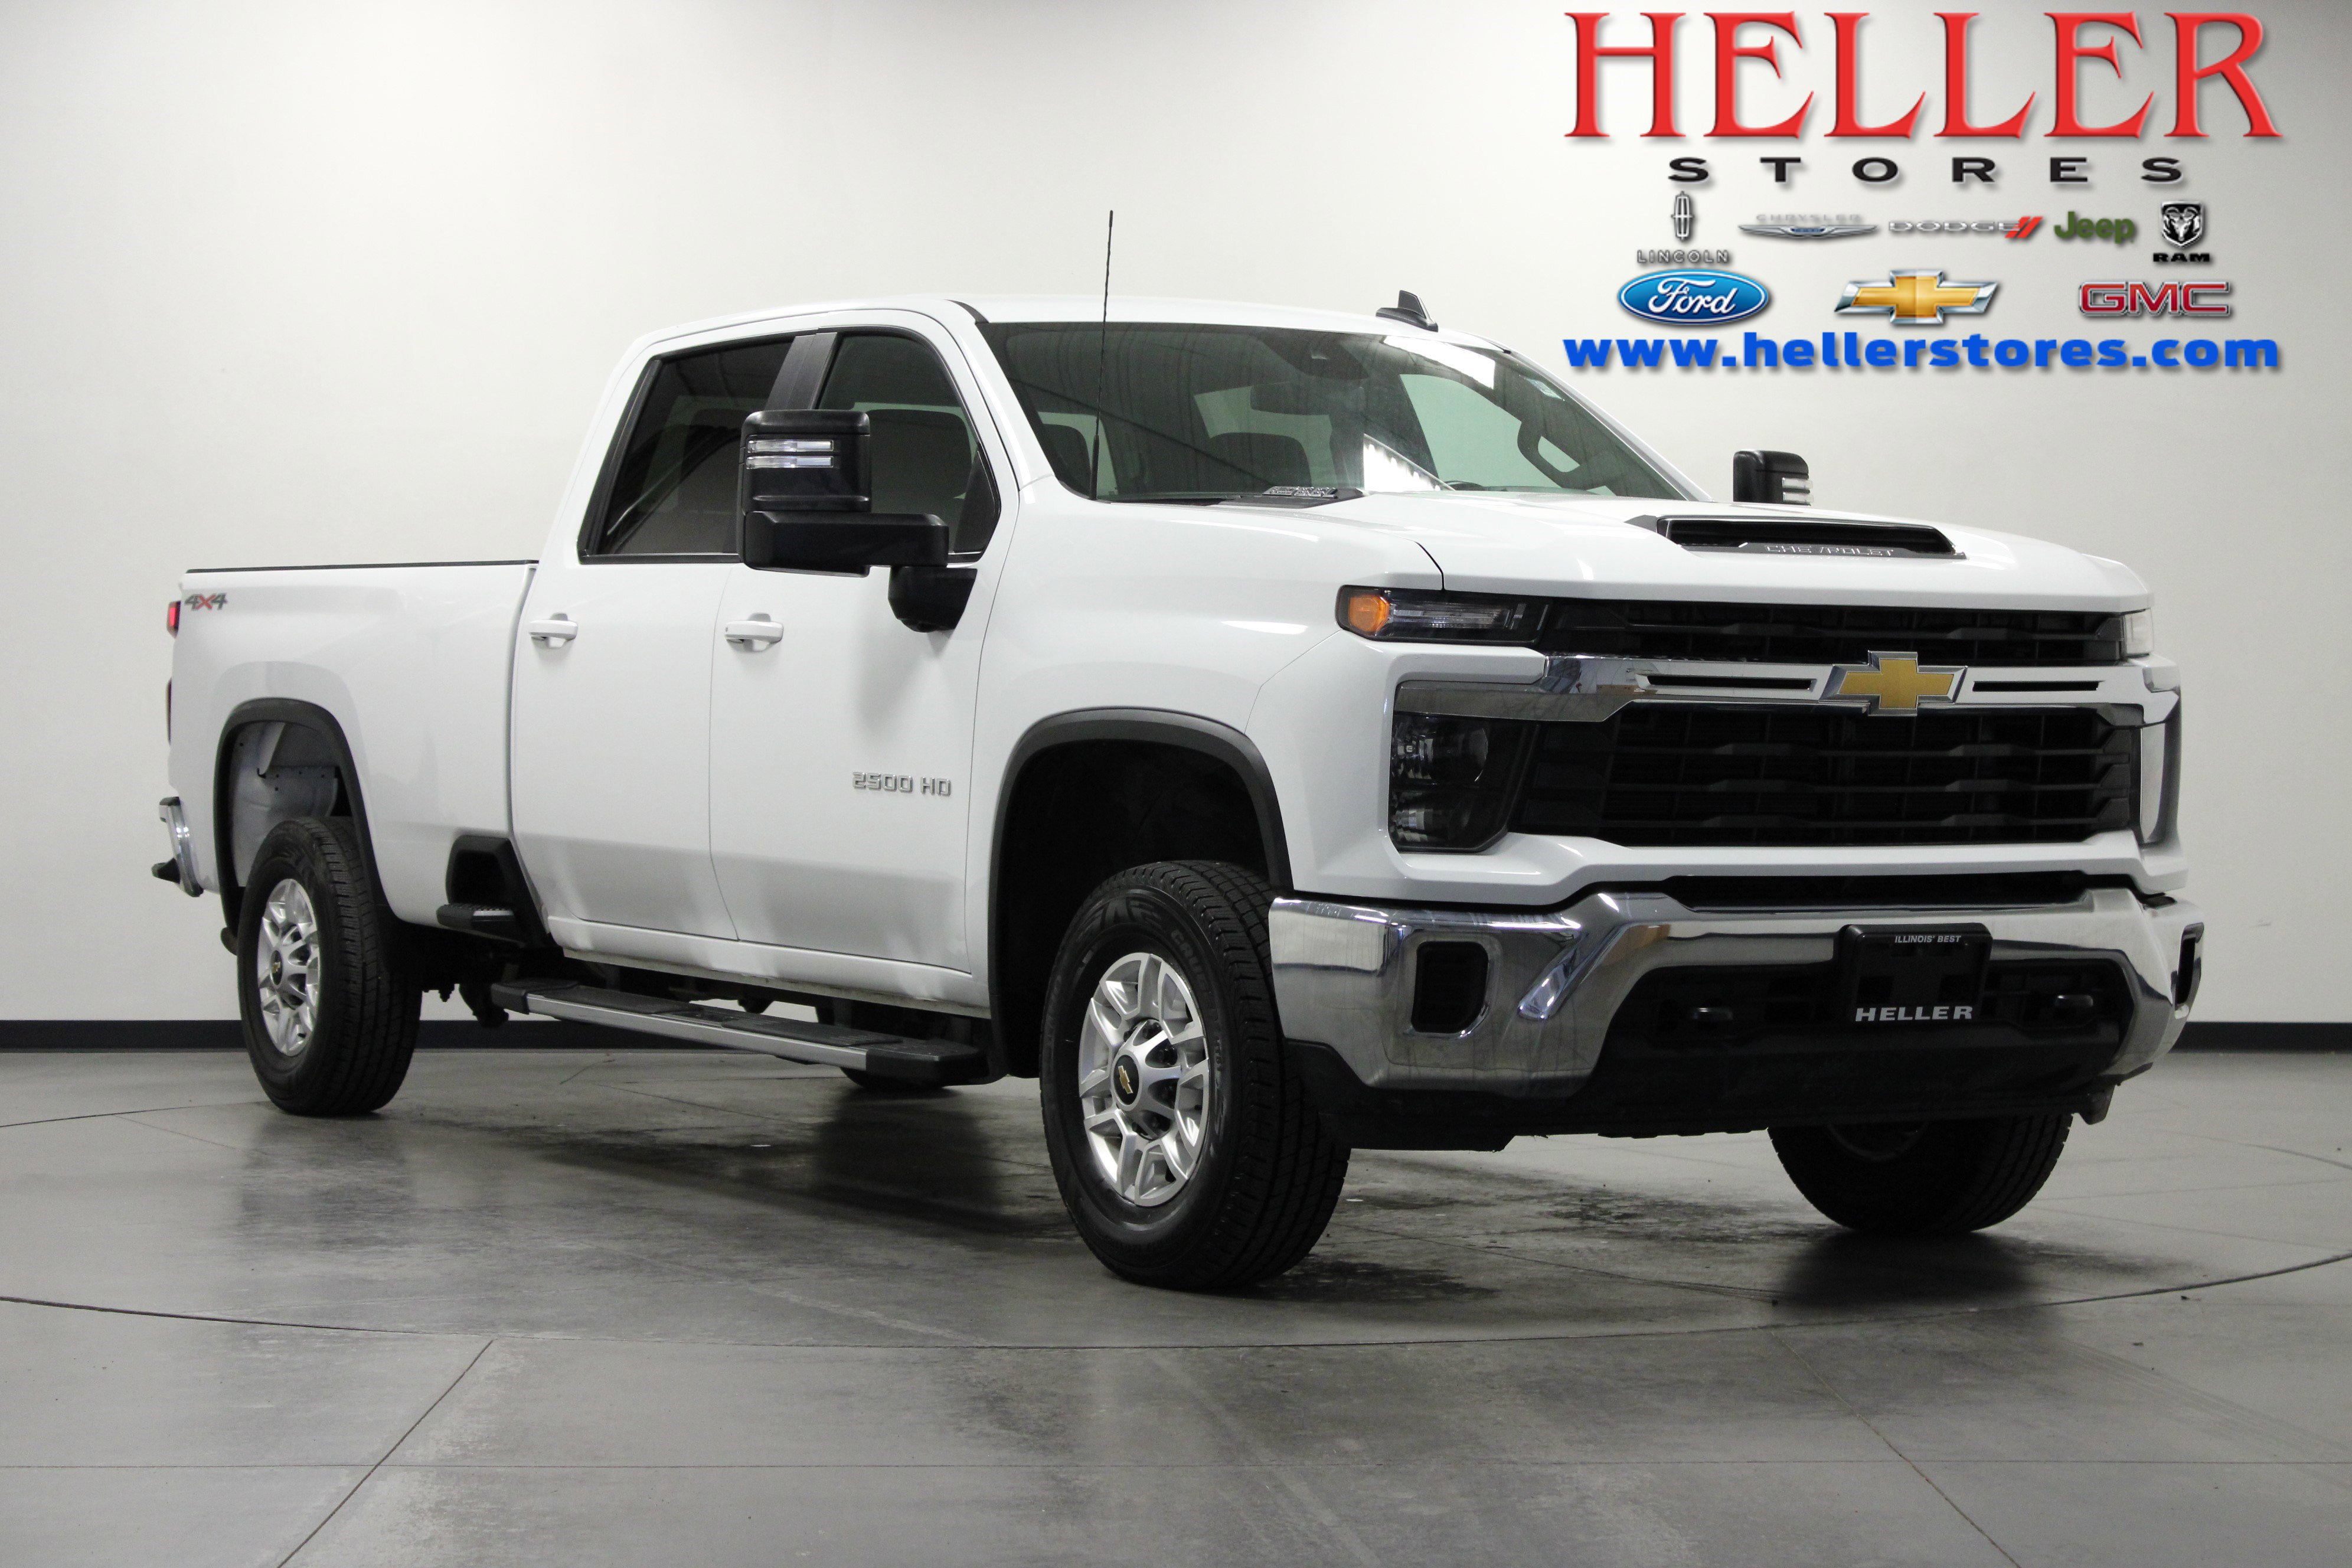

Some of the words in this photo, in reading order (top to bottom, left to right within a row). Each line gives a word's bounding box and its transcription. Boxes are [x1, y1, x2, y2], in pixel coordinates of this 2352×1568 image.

[1764, 544, 1894, 557] CHEVROLET
[852, 772, 913, 793] 2500
[920, 776, 951, 796] HD
[1937, 935, 1962, 943] BEST
[1855, 1005, 1973, 1022] HELLER
